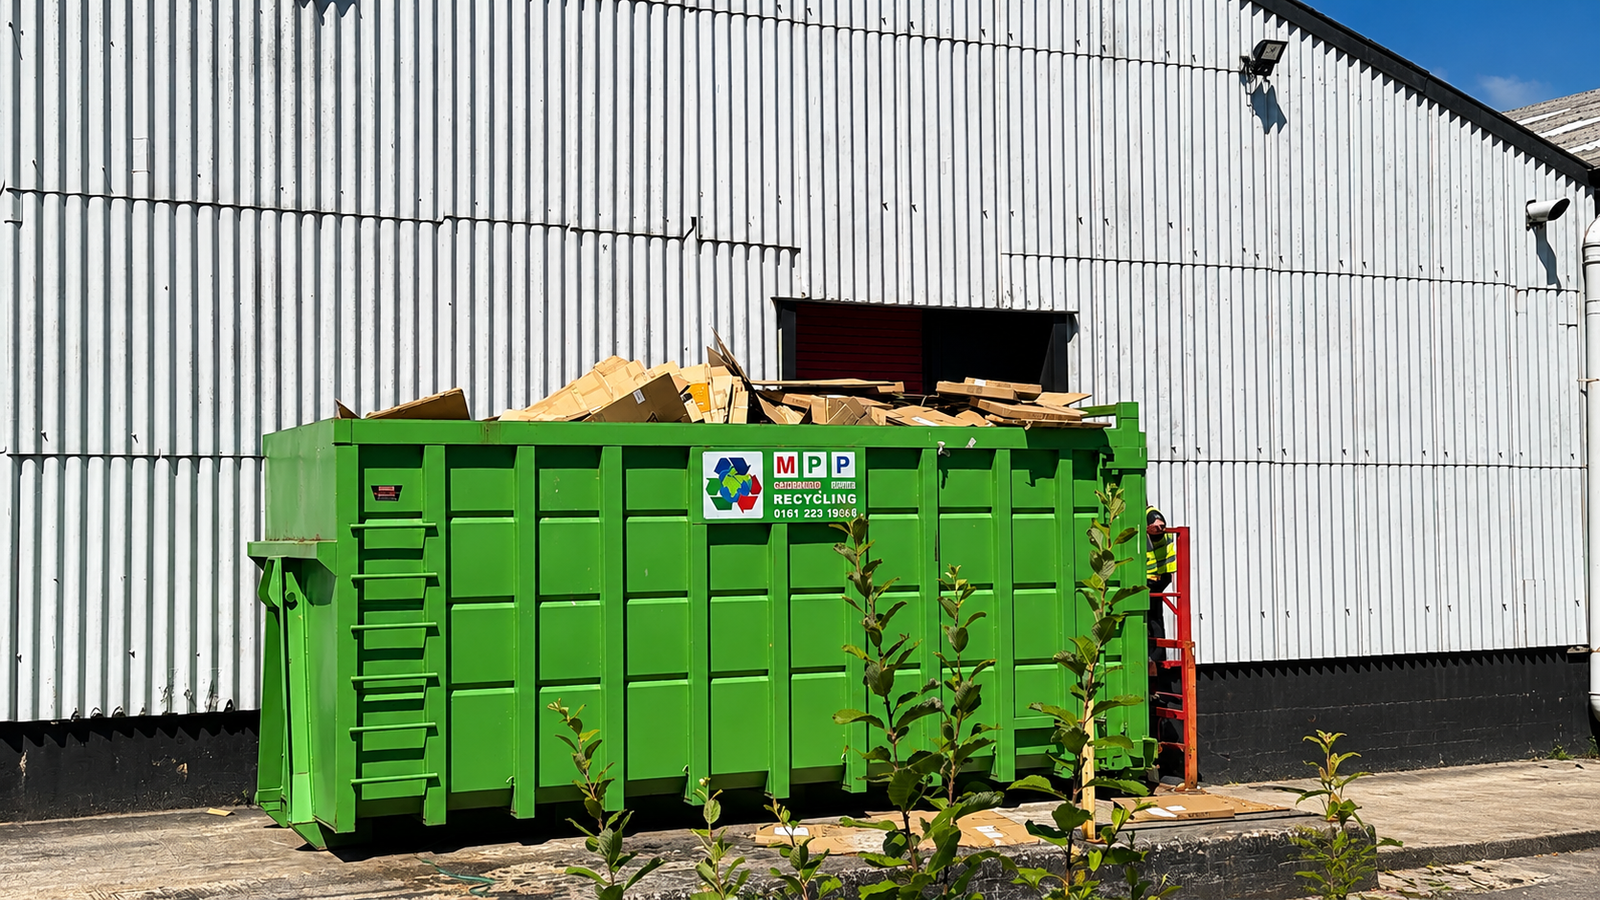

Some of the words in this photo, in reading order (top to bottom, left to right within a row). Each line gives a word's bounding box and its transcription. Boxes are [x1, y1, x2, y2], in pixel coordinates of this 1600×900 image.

[774, 494, 857, 504] RECYCLING
[774, 509, 799, 518] 0161
[804, 509, 823, 518] 223
